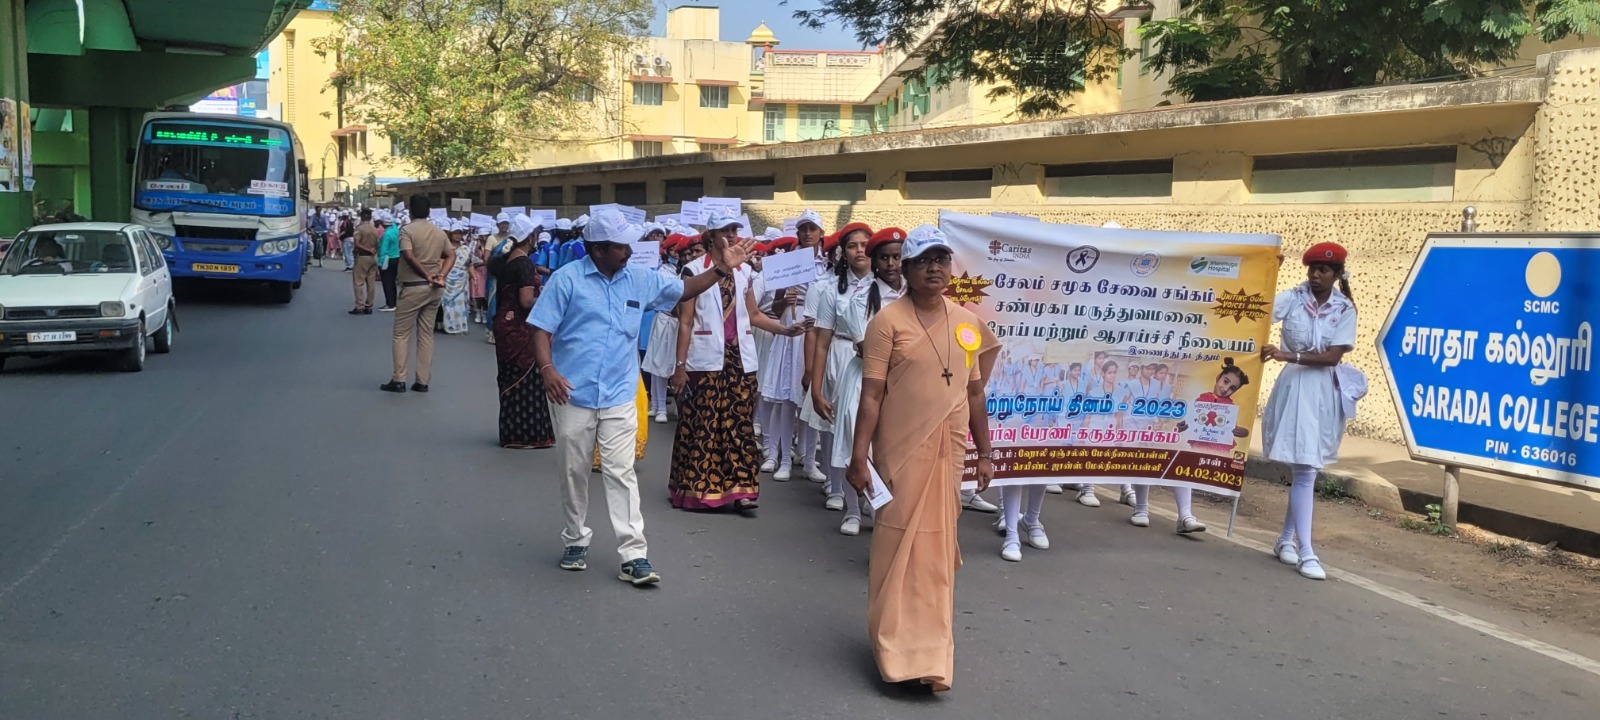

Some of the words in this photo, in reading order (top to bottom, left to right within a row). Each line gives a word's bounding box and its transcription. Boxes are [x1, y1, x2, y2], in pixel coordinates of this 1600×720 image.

[1001, 243, 1033, 254] Caritas
[995, 273, 1046, 291] சேலம்
[1051, 278, 1092, 296] சமூக
[1097, 278, 1158, 299] சேவை
[1162, 286, 1216, 304] சங்கம்
[1220, 293, 1248, 302] UNITING
[995, 297, 1070, 317] சண்முகா
[1074, 302, 1208, 327] மருத்துவமனை,
[1214, 308, 1239, 316] TAKING
[1222, 301, 1246, 309] VOICES
[1523, 300, 1560, 314] SCMC
[1033, 323, 1089, 341] மற்றும்
[1093, 328, 1175, 346] ஆராய்ச்சி
[1178, 331, 1257, 353] நிலையம்
[1128, 345, 1180, 360] இணைந்து
[1181, 350, 1222, 362] நடத்தும்
[1400, 325, 1478, 373] சாரதா
[1485, 319, 1592, 386] கல்லூரி
[986, 391, 1063, 421] ற்றுநோய்
[1067, 392, 1115, 418] தினம்
[1131, 398, 1188, 419] 2023
[1411, 383, 1492, 427] SARADA
[1498, 393, 1600, 443] COLLEGE
[1018, 448, 1048, 458] ஹோலி
[1198, 457, 1222, 467] நாள்
[1485, 439, 1509, 455] PIN
[1520, 444, 1577, 467] 636016
[1175, 464, 1243, 487] 04.02.2023
